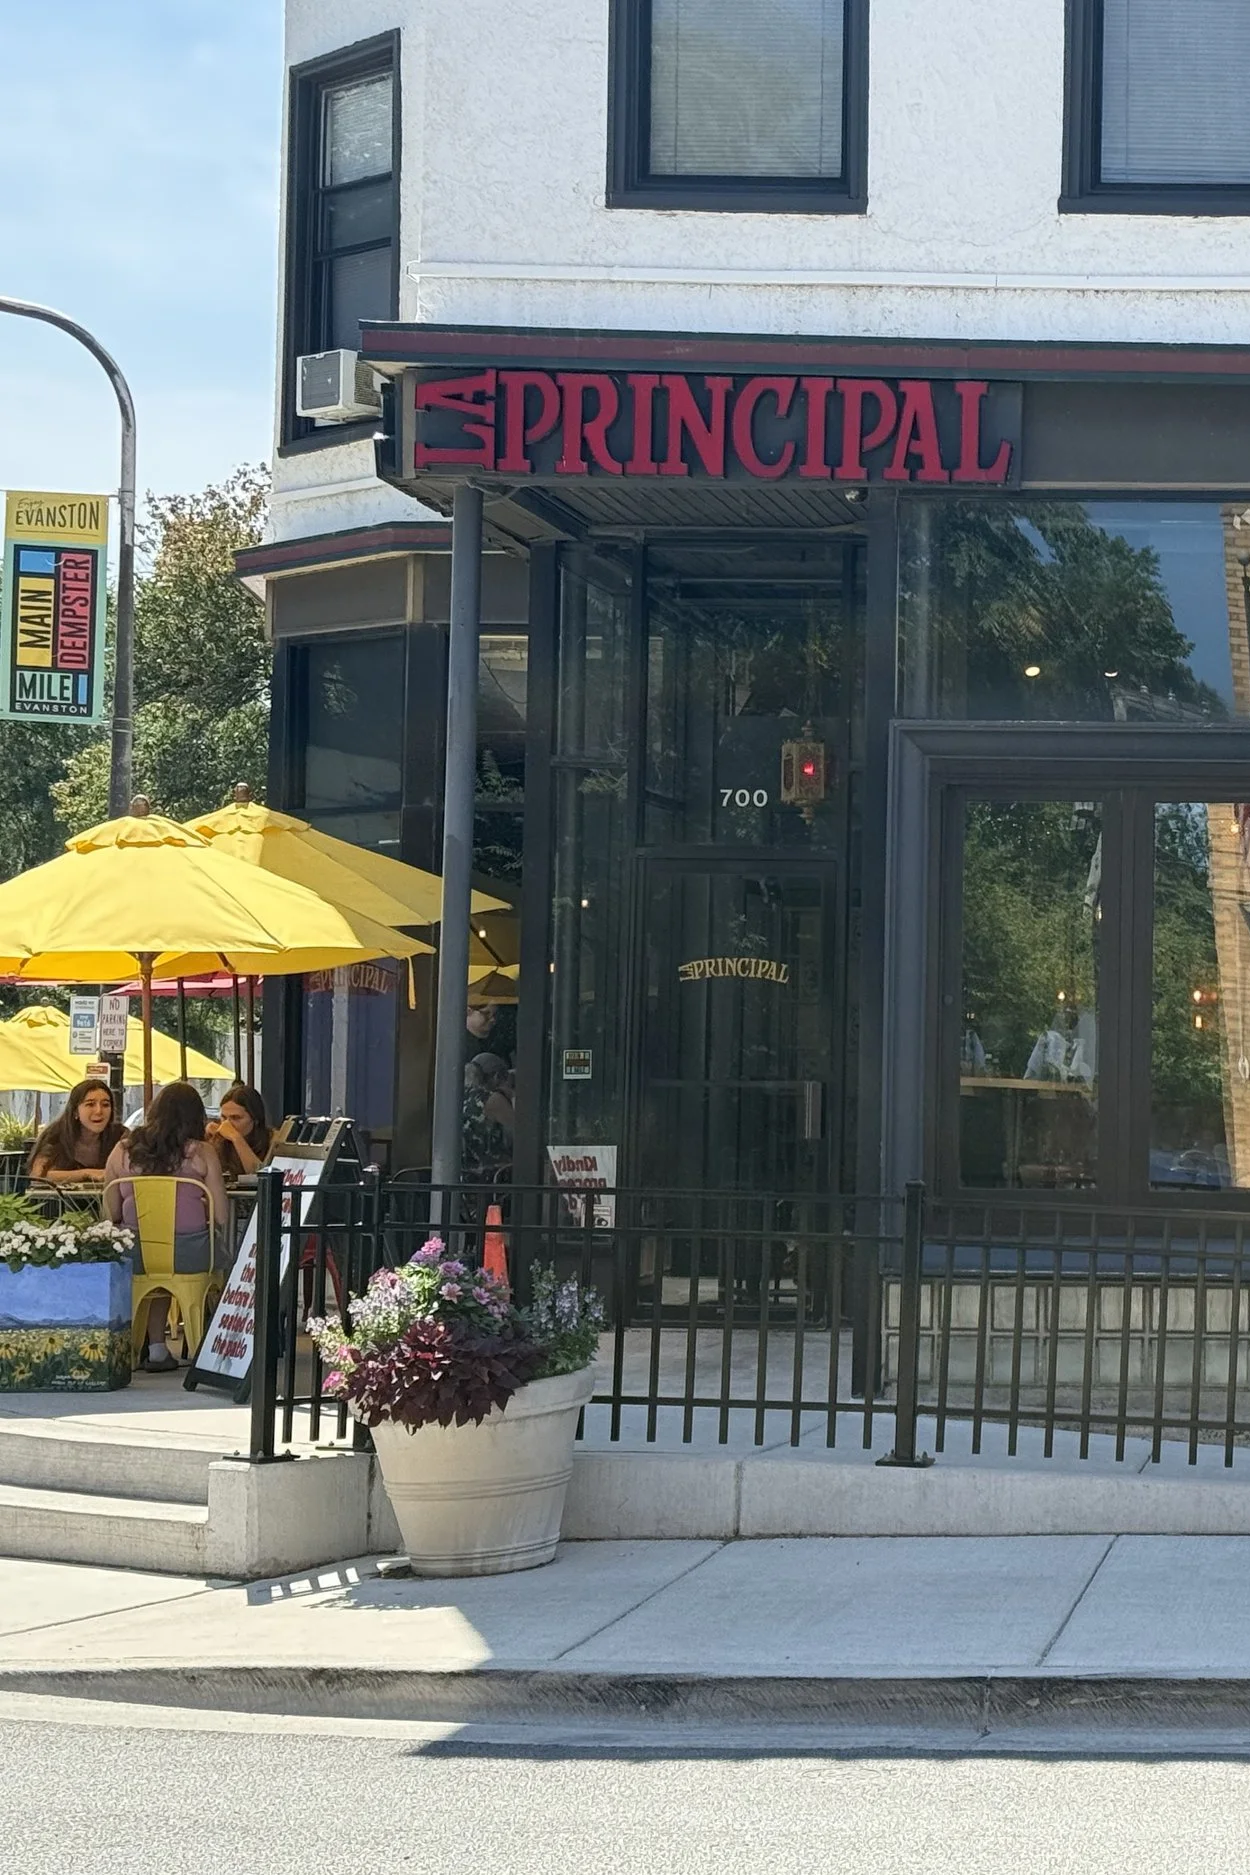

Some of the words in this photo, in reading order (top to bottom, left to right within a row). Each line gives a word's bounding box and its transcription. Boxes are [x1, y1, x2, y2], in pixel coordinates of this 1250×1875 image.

[414, 368, 496, 471] LA
[497, 370, 1012, 484] PRINCIPAL
[15, 501, 99, 530] EVANSTON
[19, 589, 53, 649] MAIN
[59, 557, 91, 665] DEMPSTER
[18, 672, 72, 702] MILE
[15, 702, 88, 714] EVANSTON
[720, 789, 769, 808] 700
[691, 957, 789, 984] PRINCIPAL
[109, 999, 120, 1011] NO
